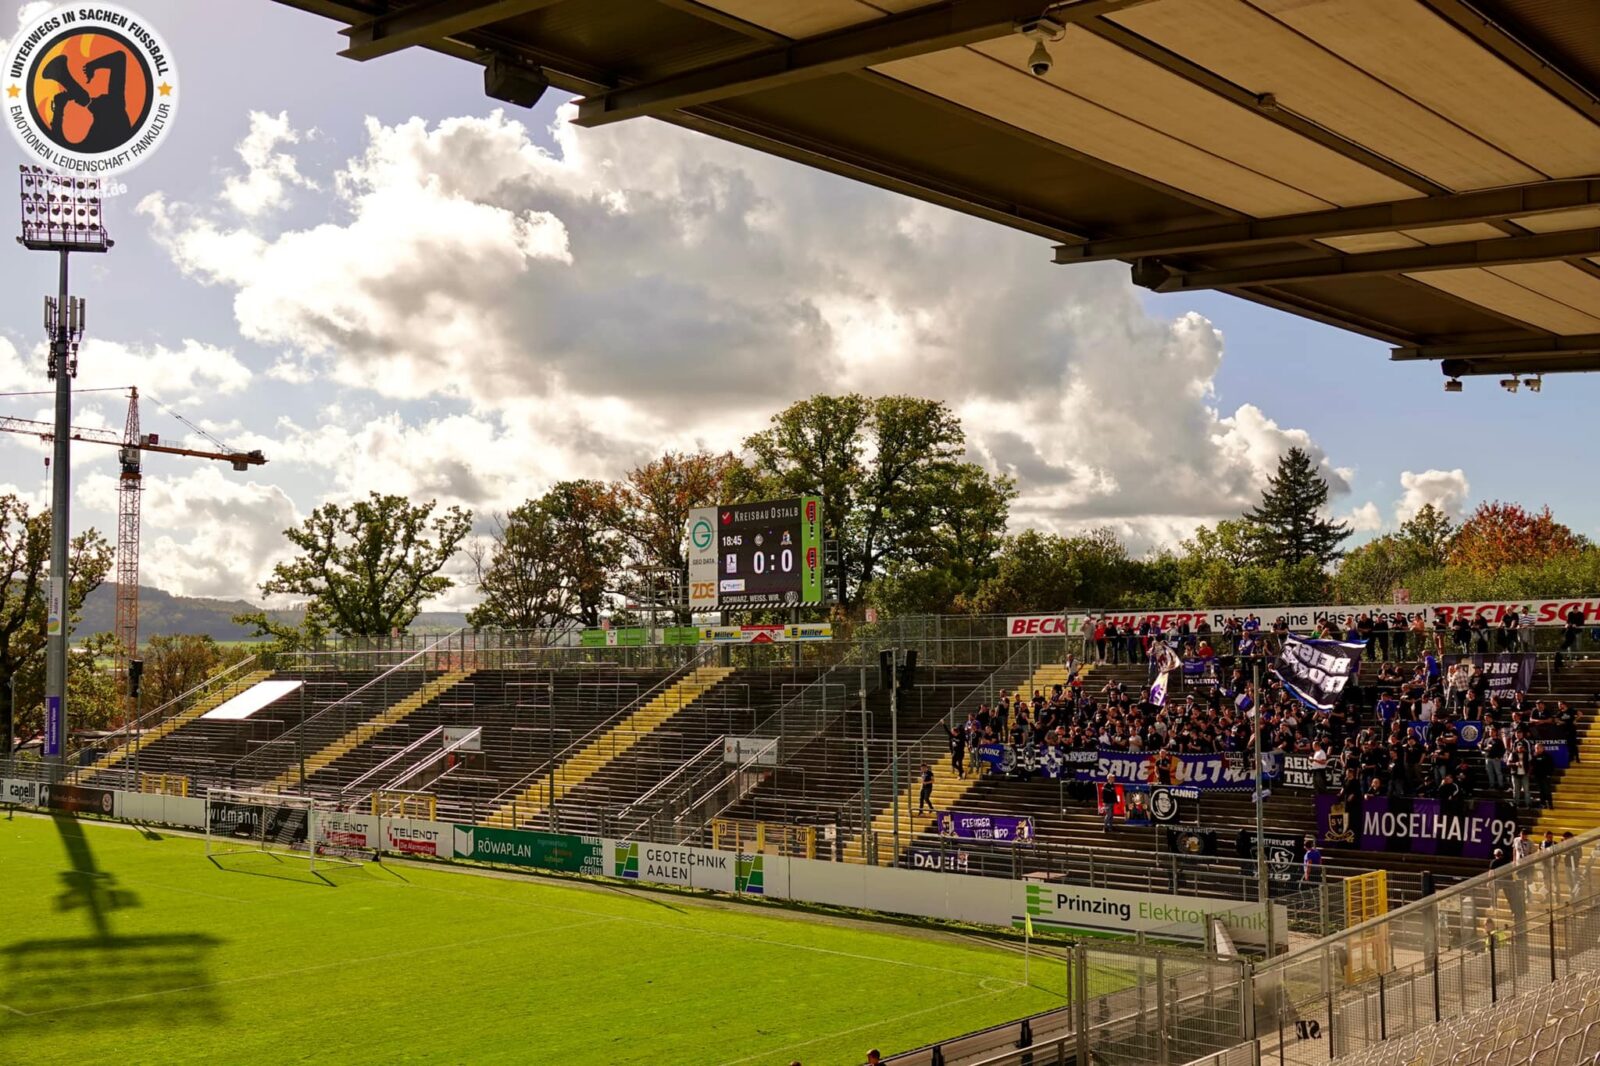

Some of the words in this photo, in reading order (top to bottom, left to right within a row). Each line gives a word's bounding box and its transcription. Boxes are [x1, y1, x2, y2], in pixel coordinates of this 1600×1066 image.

[771, 507, 799, 519] OSTALB
[722, 535, 742, 546] 18:45
[1369, 608, 1427, 623] beser!
[801, 628, 823, 636] Miller
[1483, 662, 1519, 674] FANS
[1487, 676, 1513, 686] EGEN
[1284, 756, 1314, 770] REIS
[1284, 771, 1342, 786] TRUE
[10, 782, 36, 800] capelli
[1170, 788, 1198, 799] CANNIS
[209, 806, 259, 825] widmann
[328, 821, 369, 832] TELENOT
[394, 827, 439, 840] TELENOT
[798, 831, 806, 842] 20
[478, 837, 531, 858] RÖWAPLAN
[646, 849, 726, 869] GEOTECHNIK
[647, 865, 688, 879] AALEN
[1057, 893, 1131, 921] Prinzing
[1138, 902, 1267, 930] Elektrotchnik
